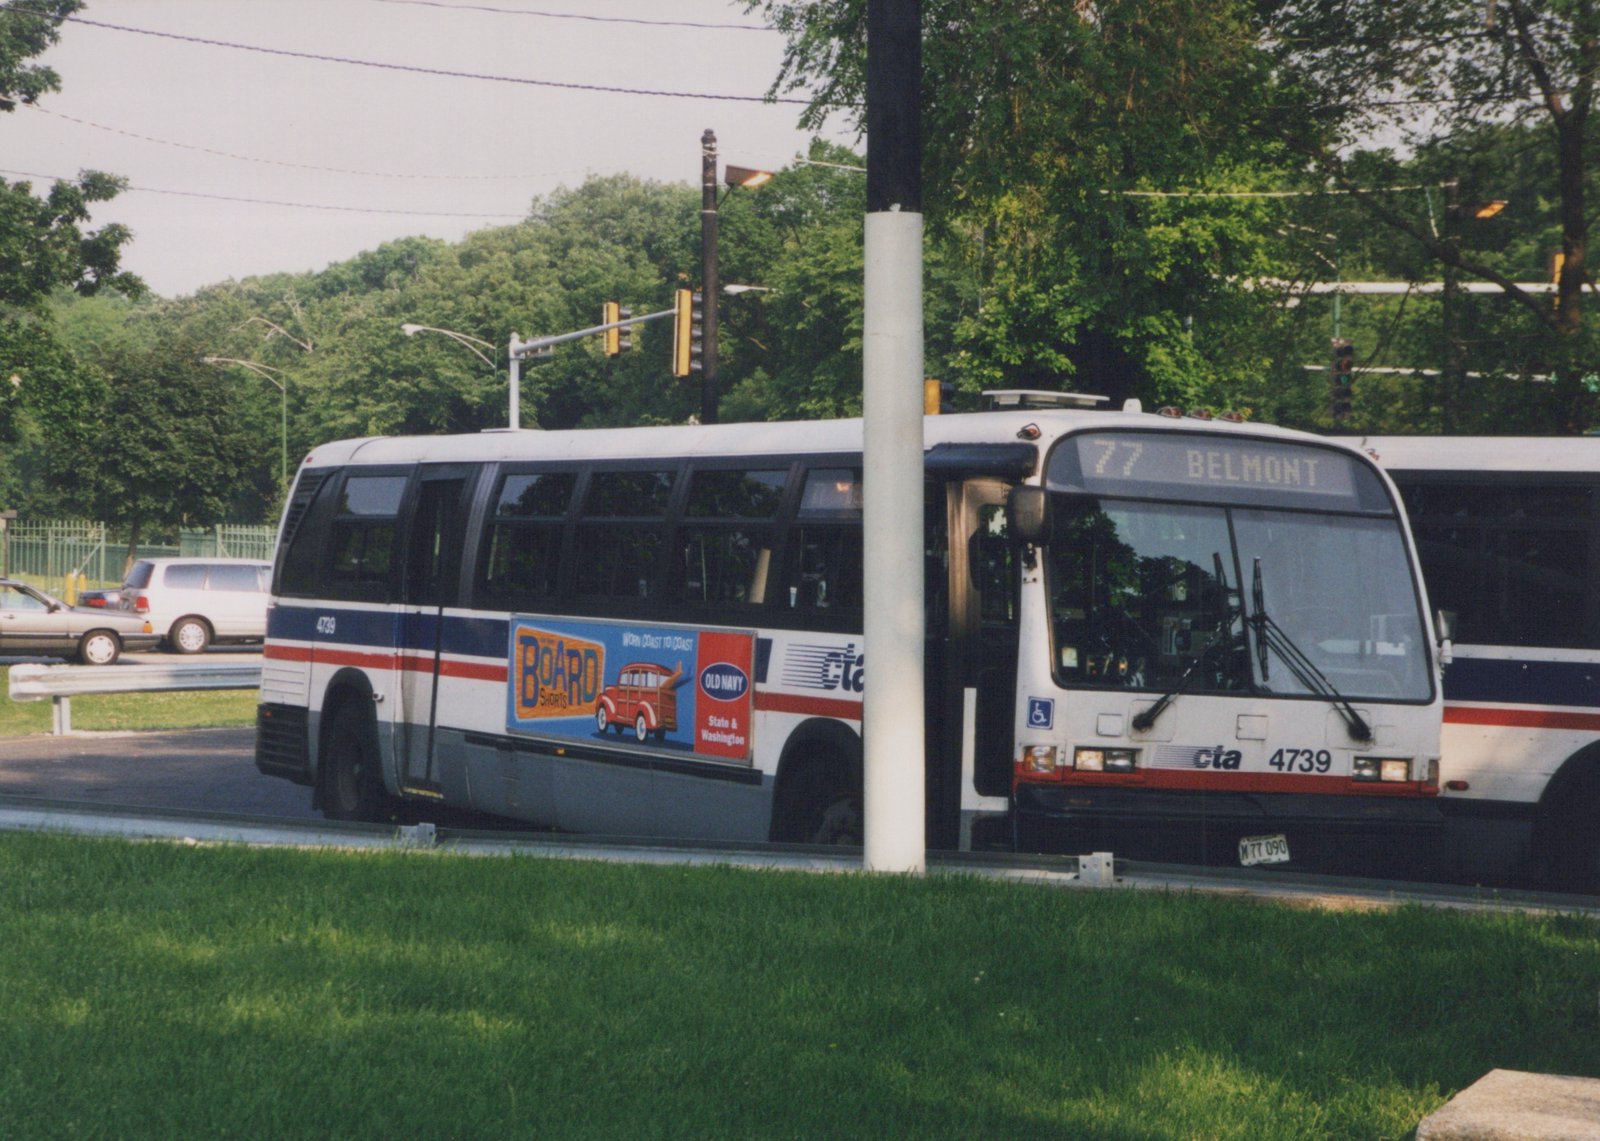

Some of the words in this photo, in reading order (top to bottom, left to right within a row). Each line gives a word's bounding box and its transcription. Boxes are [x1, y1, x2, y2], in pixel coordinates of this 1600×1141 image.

[1094, 439, 1143, 476] 77
[1187, 449, 1319, 487] BELMONT
[316, 616, 336, 634] 4739
[642, 633, 662, 649] COAST
[663, 636, 672, 648] TO
[672, 636, 694, 651] COAST
[519, 635, 598, 708] BOARD
[705, 673, 720, 689] OLD
[721, 675, 744, 692] NAVY
[708, 715, 729, 729] State
[731, 718, 738, 730] &
[701, 729, 744, 747] Washington
[1193, 745, 1242, 770] cta
[1269, 748, 1331, 773] 4739
